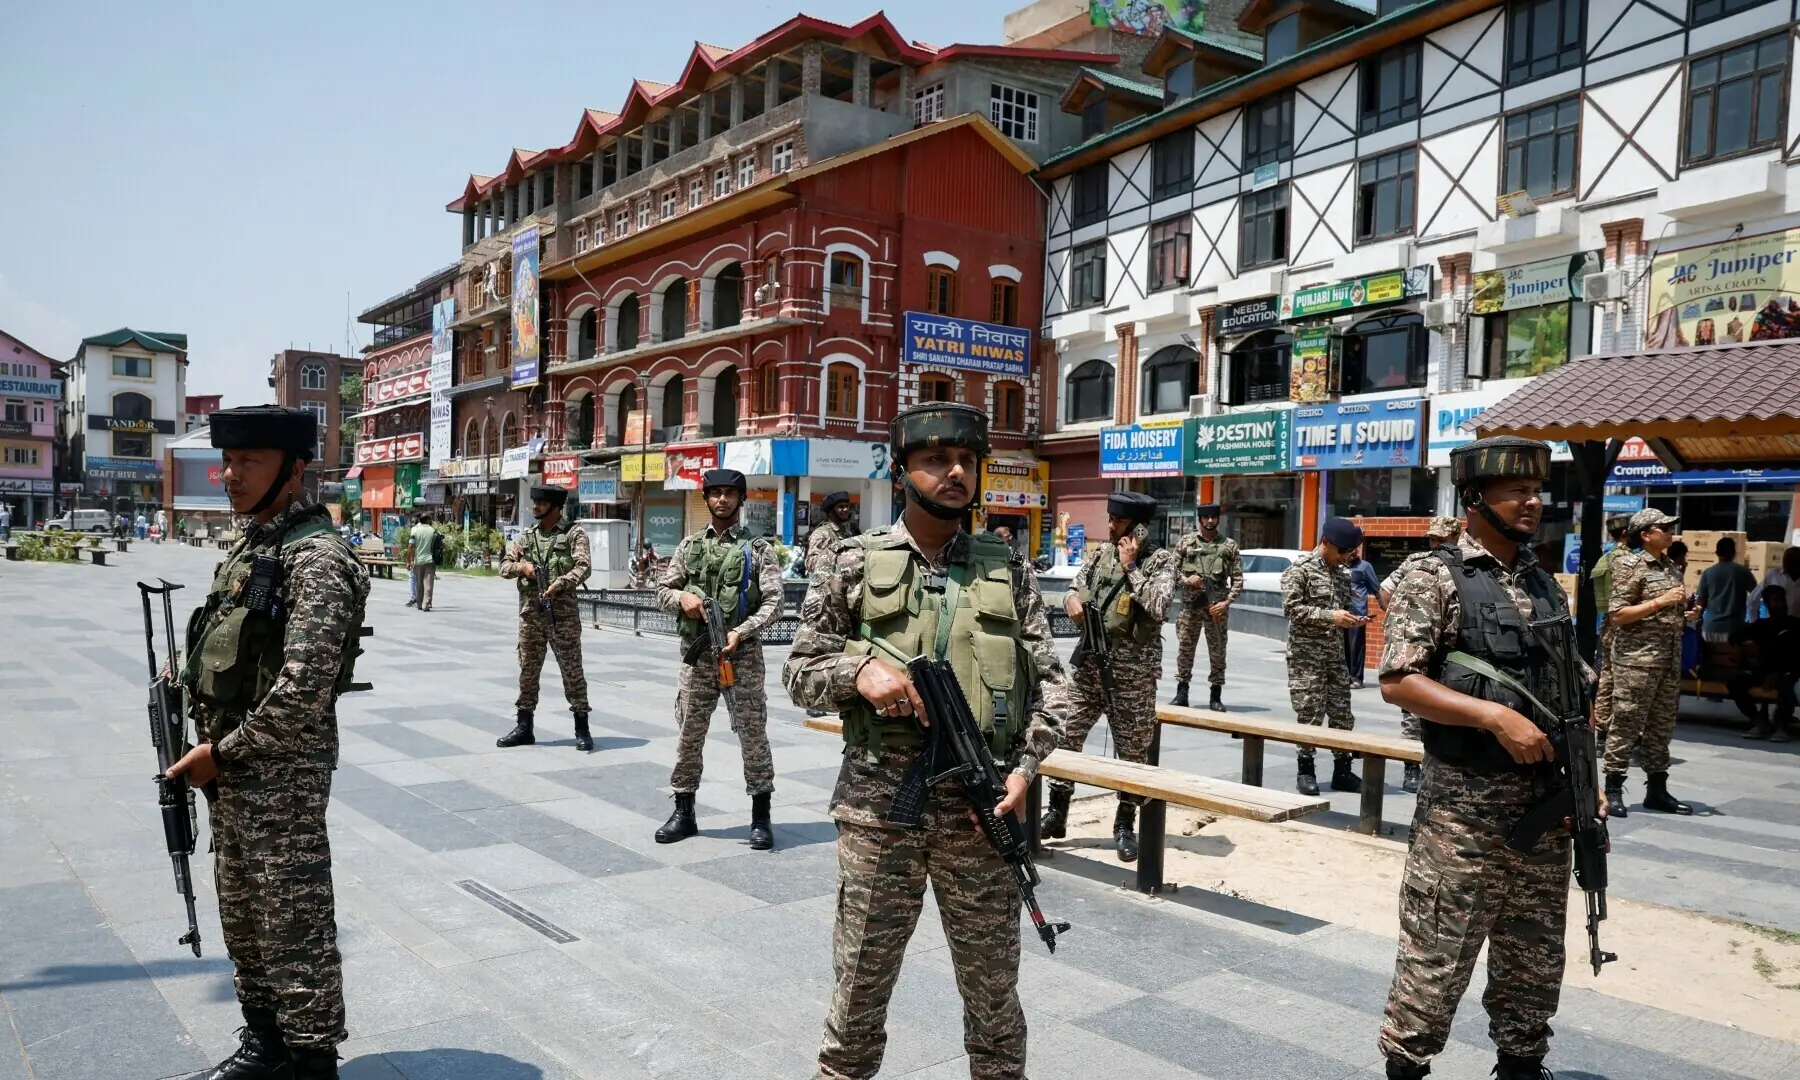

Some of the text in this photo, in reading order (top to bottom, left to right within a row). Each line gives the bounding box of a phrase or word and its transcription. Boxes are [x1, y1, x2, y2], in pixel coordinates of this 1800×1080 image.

[1705, 250, 1797, 281] Juniper
[1508, 276, 1567, 299] Juniper
[1688, 276, 1767, 297] ARTS & CRAFTS
[1296, 286, 1350, 308] PUNJABI HUT
[1233, 301, 1268, 316] NEEDS
[1222, 310, 1279, 328] EDUCATION
[911, 320, 1027, 348] यात्री निवास
[913, 335, 1025, 362] YATRI NIWAS
[912, 351, 1024, 373] SHRI SANATAN DHARAM PRATAP SABHA
[431, 405, 450, 419] NIWAS
[1297, 408, 1324, 417] SEIKO
[1386, 400, 1416, 411] CASIO
[1104, 429, 1178, 450] FIDA HOISERY
[1216, 421, 1277, 442] DESTINY
[1295, 419, 1416, 448] TIME N SOUND
[1216, 439, 1276, 450] PASHMINA HOUSE
[509, 452, 527, 462] TRADERS
[550, 459, 575, 473] TITAN
[88, 469, 114, 478] CRAFT
[117, 471, 137, 479] HIVE
[988, 465, 1028, 475] SAMSUNG
[987, 475, 1044, 493] realme
[650, 516, 675, 528] oppo
